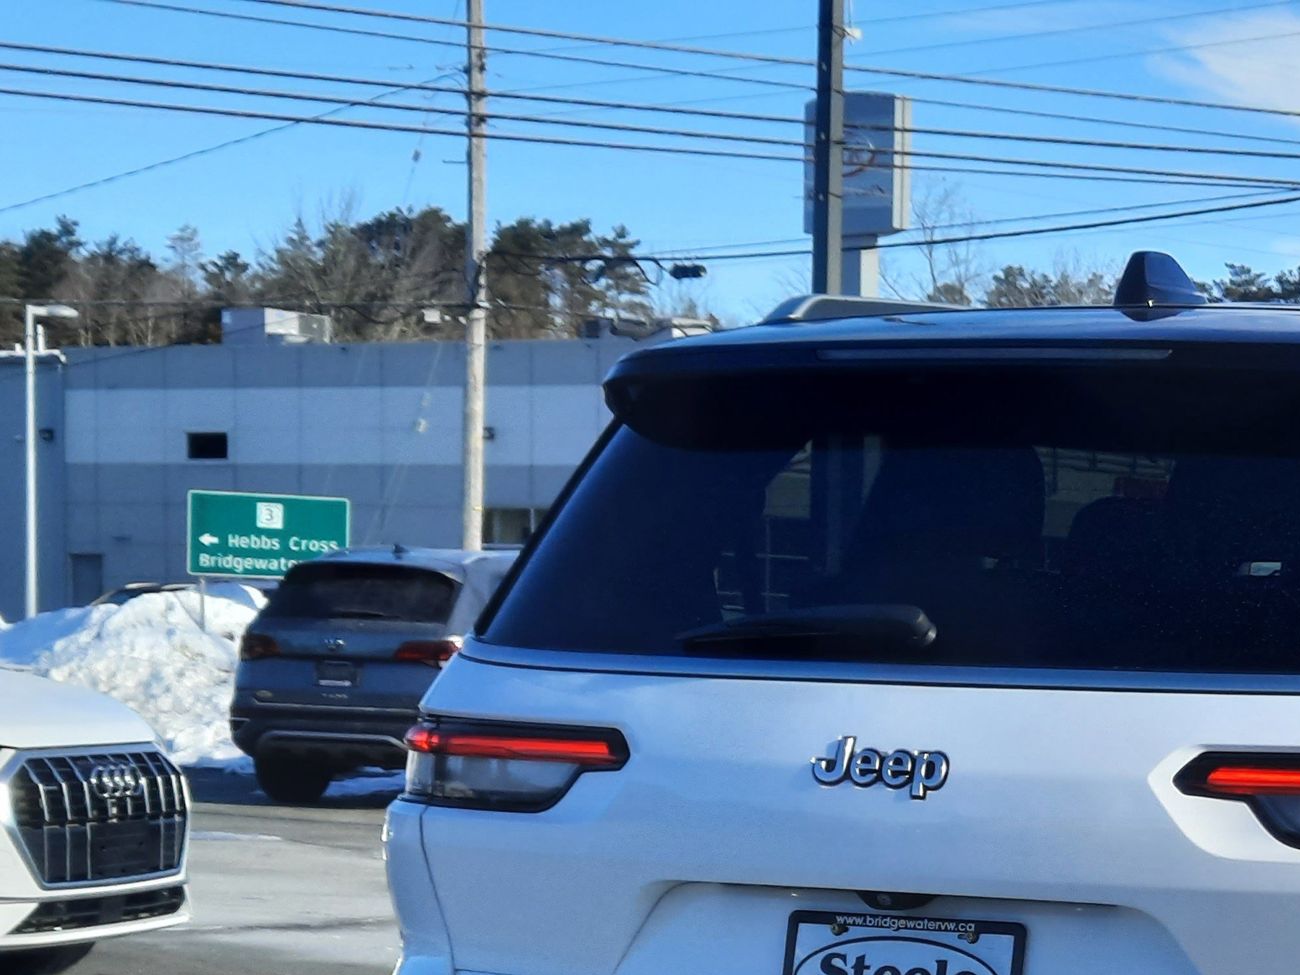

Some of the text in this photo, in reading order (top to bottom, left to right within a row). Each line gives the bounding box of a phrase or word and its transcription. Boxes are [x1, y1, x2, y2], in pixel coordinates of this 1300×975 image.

[264, 508, 274, 521] 3
[228, 534, 340, 553] Hebbs Cross
[811, 735, 950, 801] Jeep
[836, 915, 975, 931] www.bridgewatervw.ca
